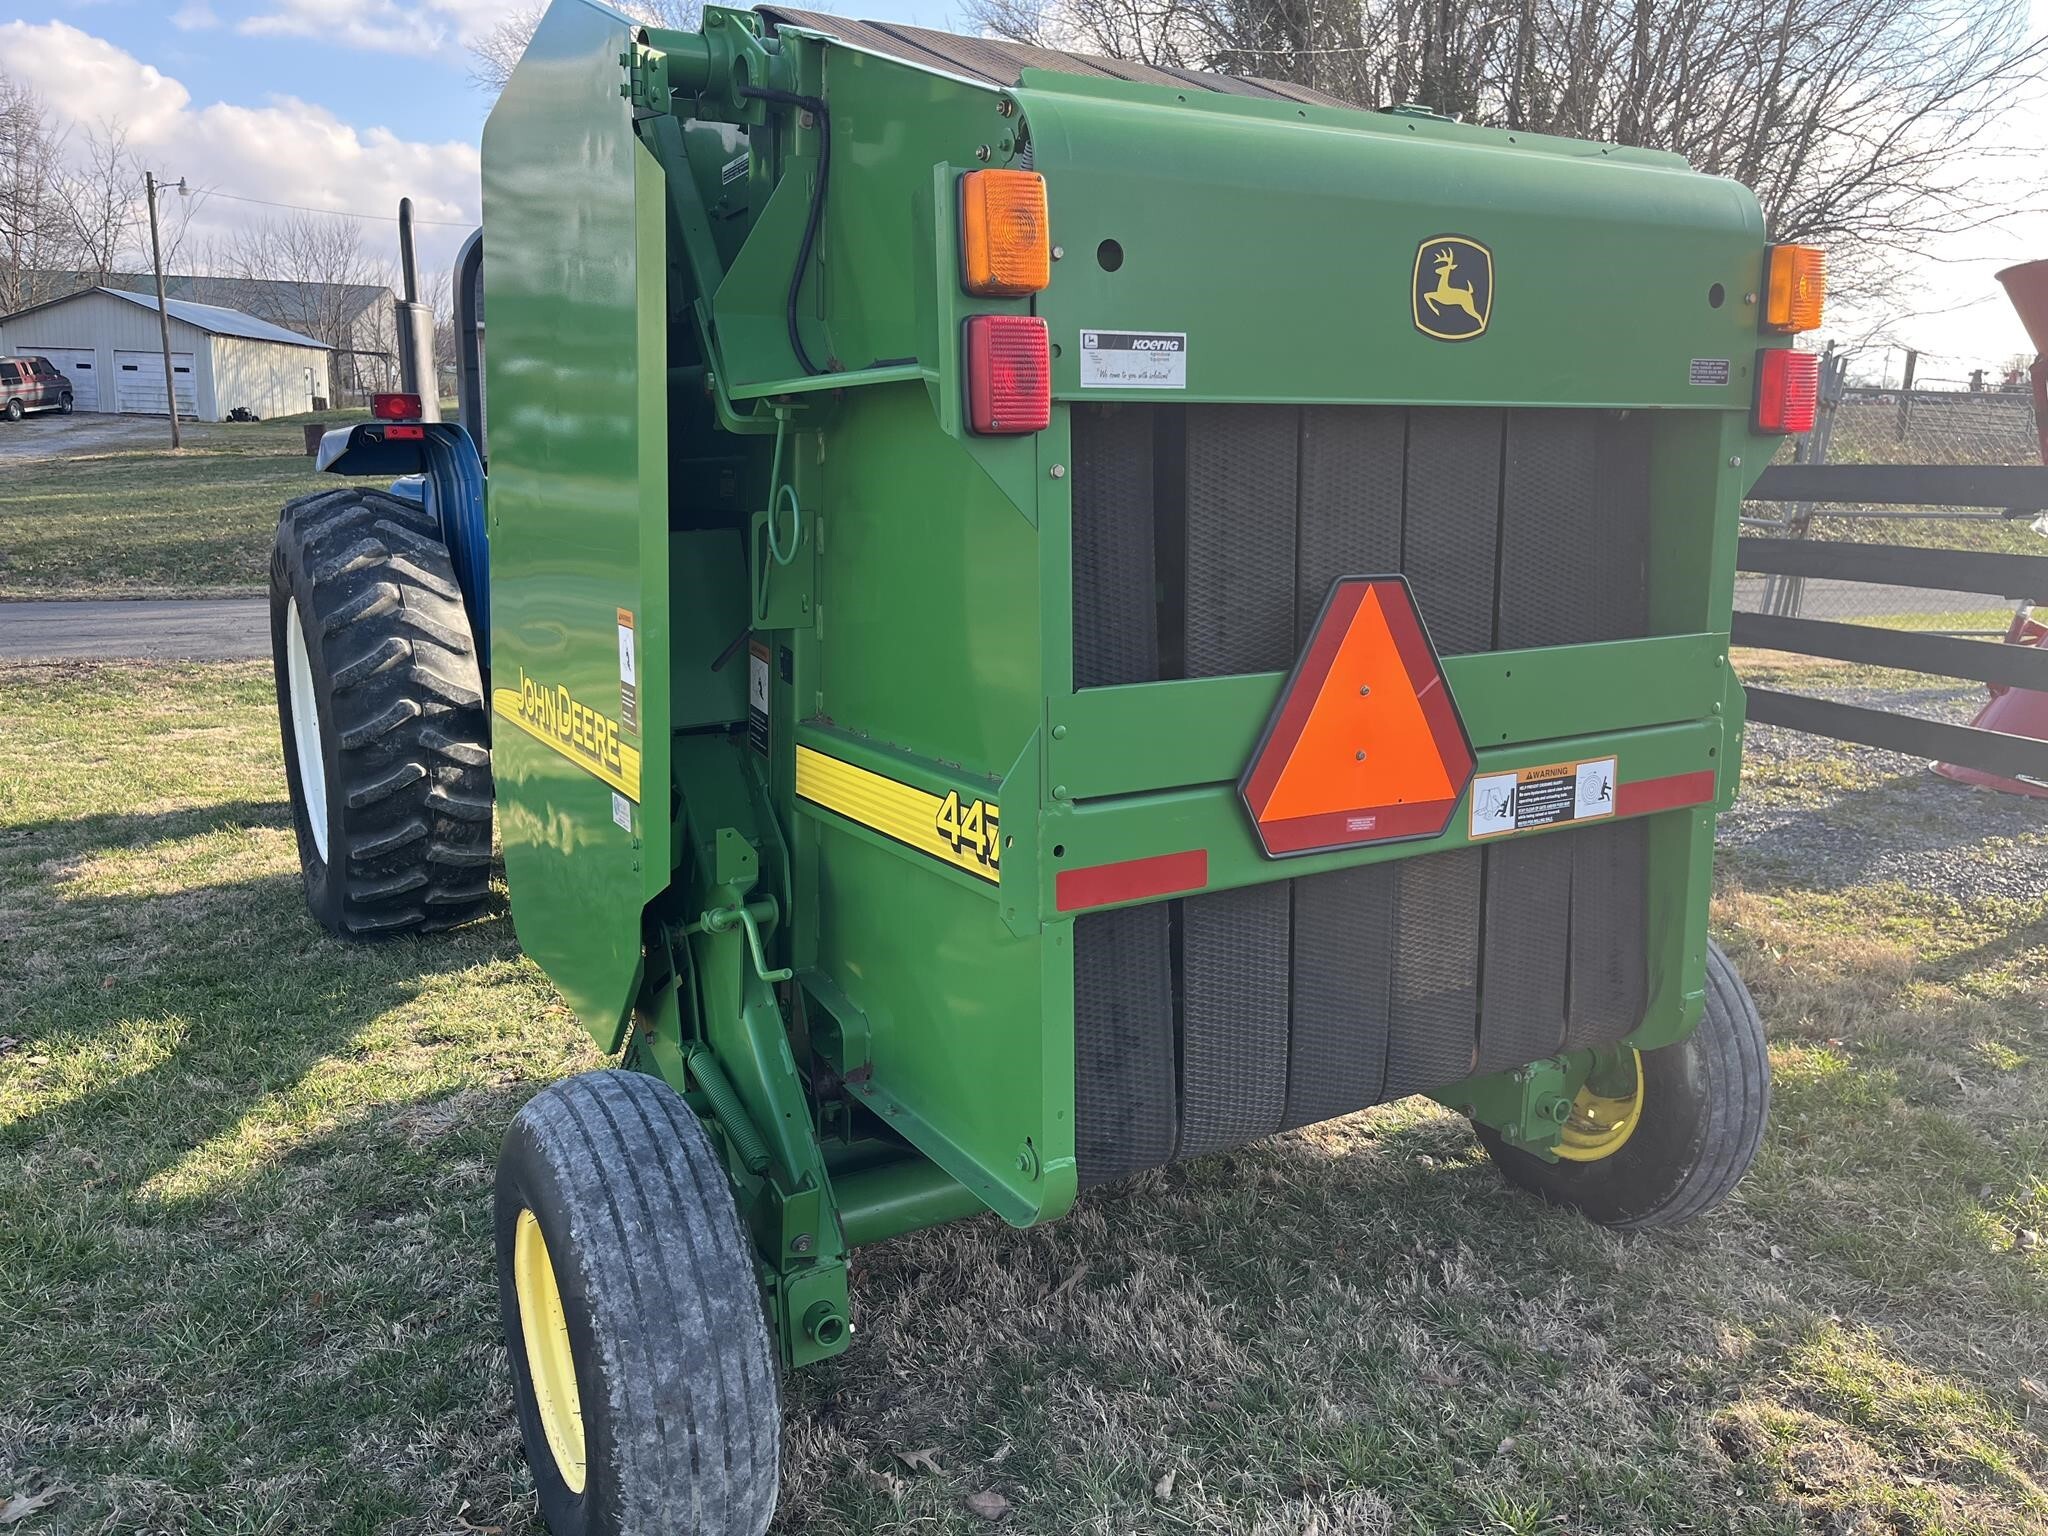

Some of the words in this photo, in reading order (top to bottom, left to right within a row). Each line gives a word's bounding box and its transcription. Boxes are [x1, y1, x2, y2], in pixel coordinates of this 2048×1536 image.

[517, 666, 556, 736] JOHN
[557, 683, 622, 769] DEERE
[1532, 767, 1568, 779] WARNING
[936, 789, 1000, 868] 447
